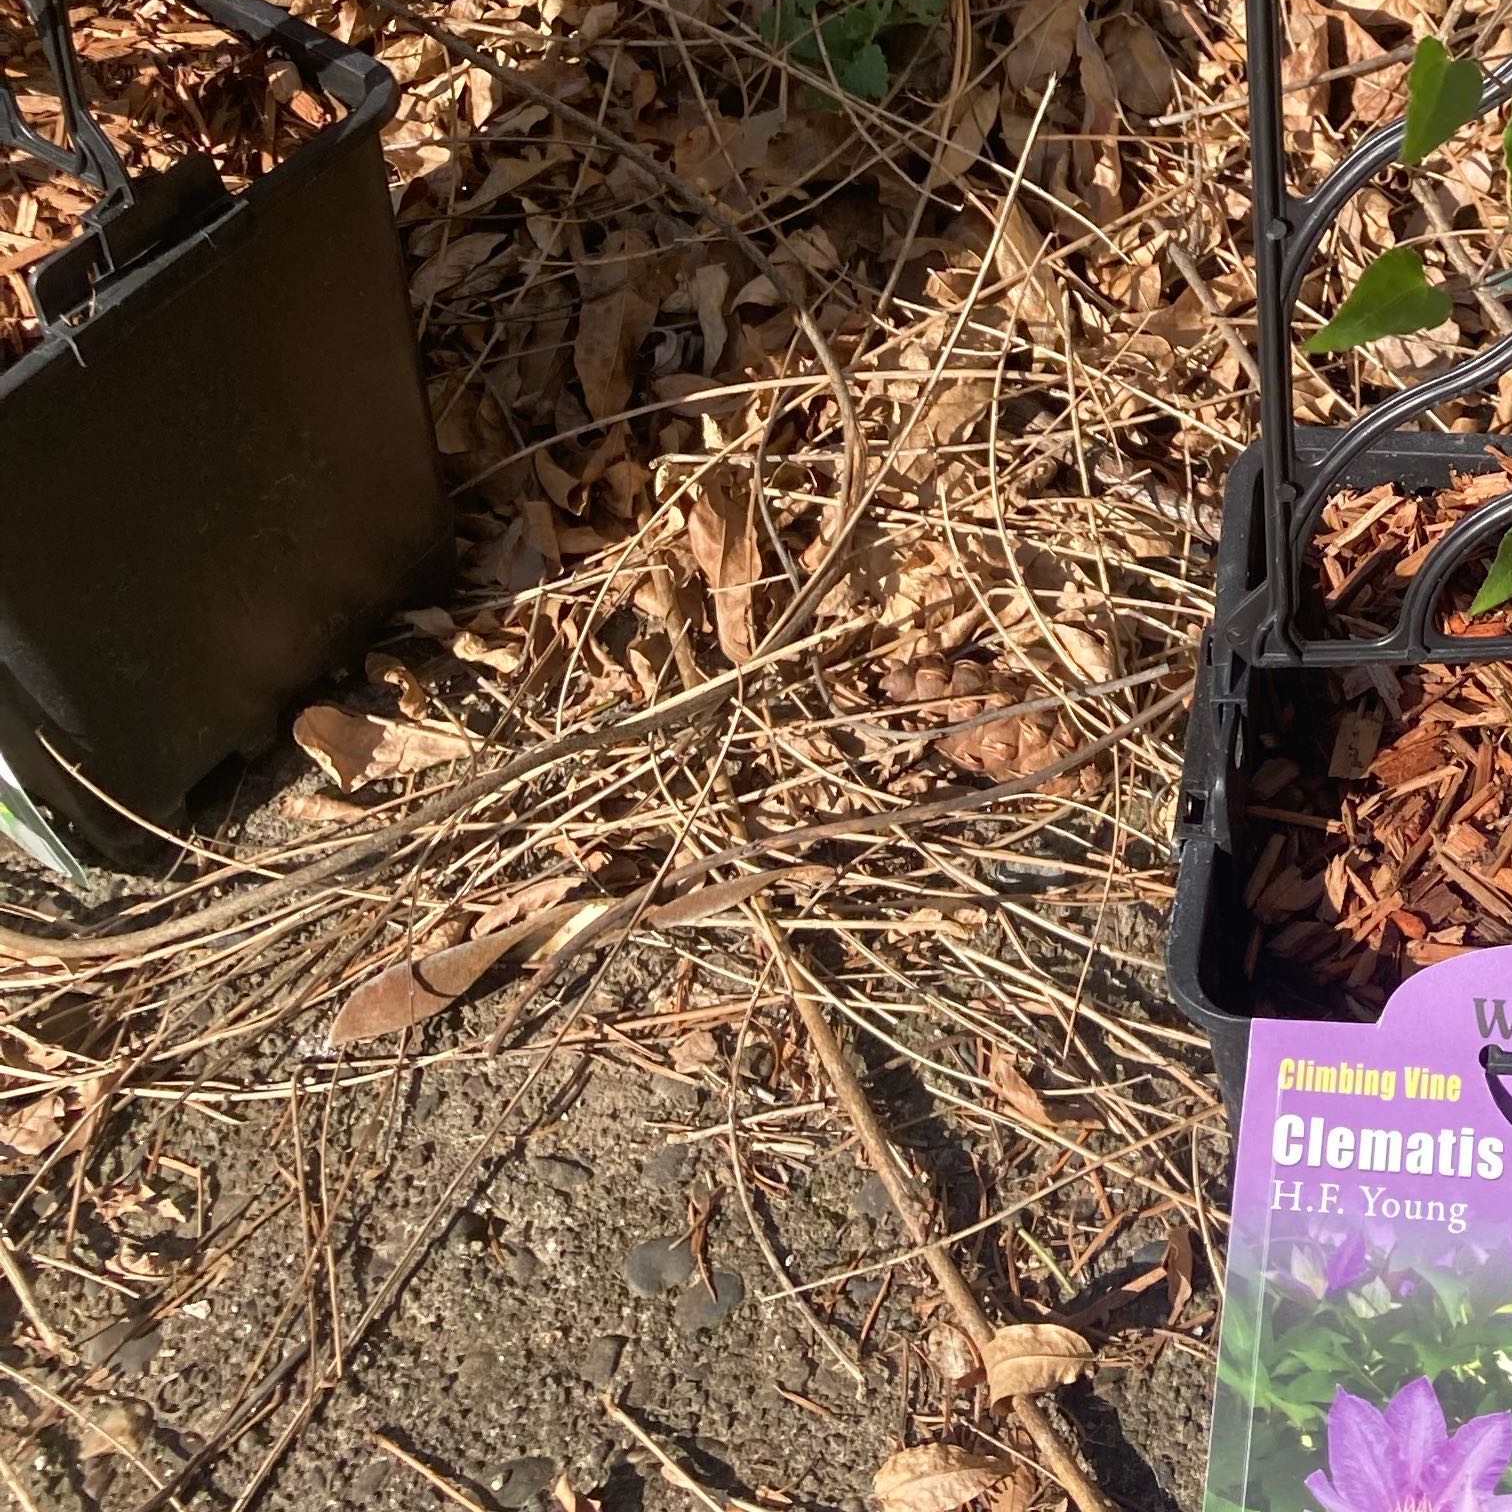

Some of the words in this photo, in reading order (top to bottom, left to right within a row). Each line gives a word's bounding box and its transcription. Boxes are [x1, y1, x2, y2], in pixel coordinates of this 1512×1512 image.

[1278, 1057, 1395, 1101] Climbing
[1403, 1067, 1462, 1102] Vine
[1271, 1113, 1505, 1180] Clematis
[1271, 1180, 1344, 1216] H.F.
[1360, 1186, 1469, 1234] Young
